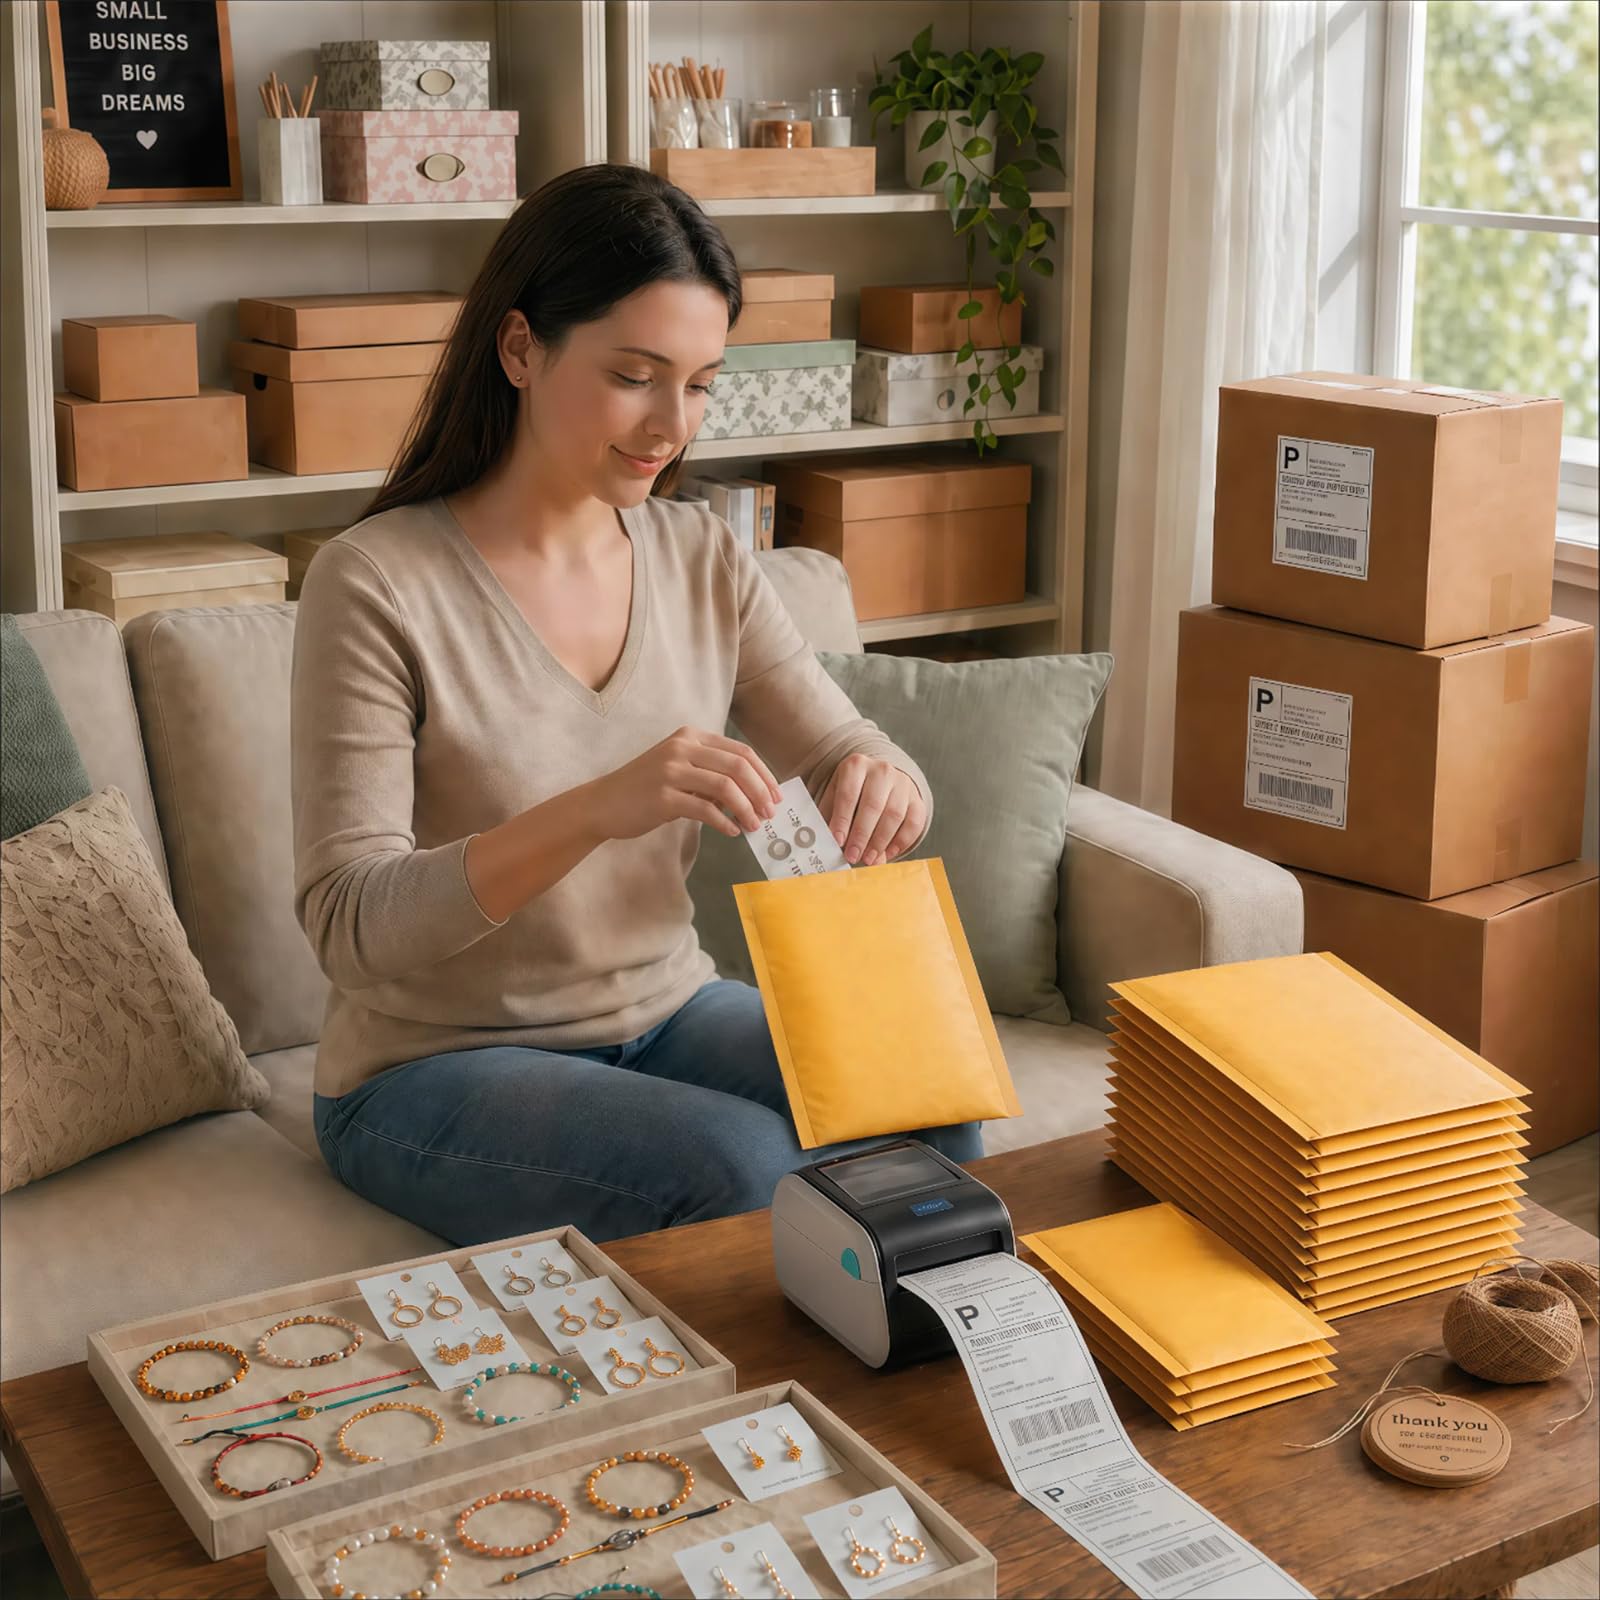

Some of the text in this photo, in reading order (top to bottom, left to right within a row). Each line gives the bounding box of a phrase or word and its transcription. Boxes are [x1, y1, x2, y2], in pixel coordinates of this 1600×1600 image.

[96, 1, 167, 19] SMALL
[89, 32, 189, 51] BUSINESS
[121, 64, 156, 81] BIG
[101, 94, 185, 111] DREAMS
[1284, 446, 1299, 469] P
[1256, 687, 1274, 713] P
[954, 1304, 979, 1330] P
[1392, 1413, 1488, 1431] thank you
[1043, 1487, 1065, 1503] P
